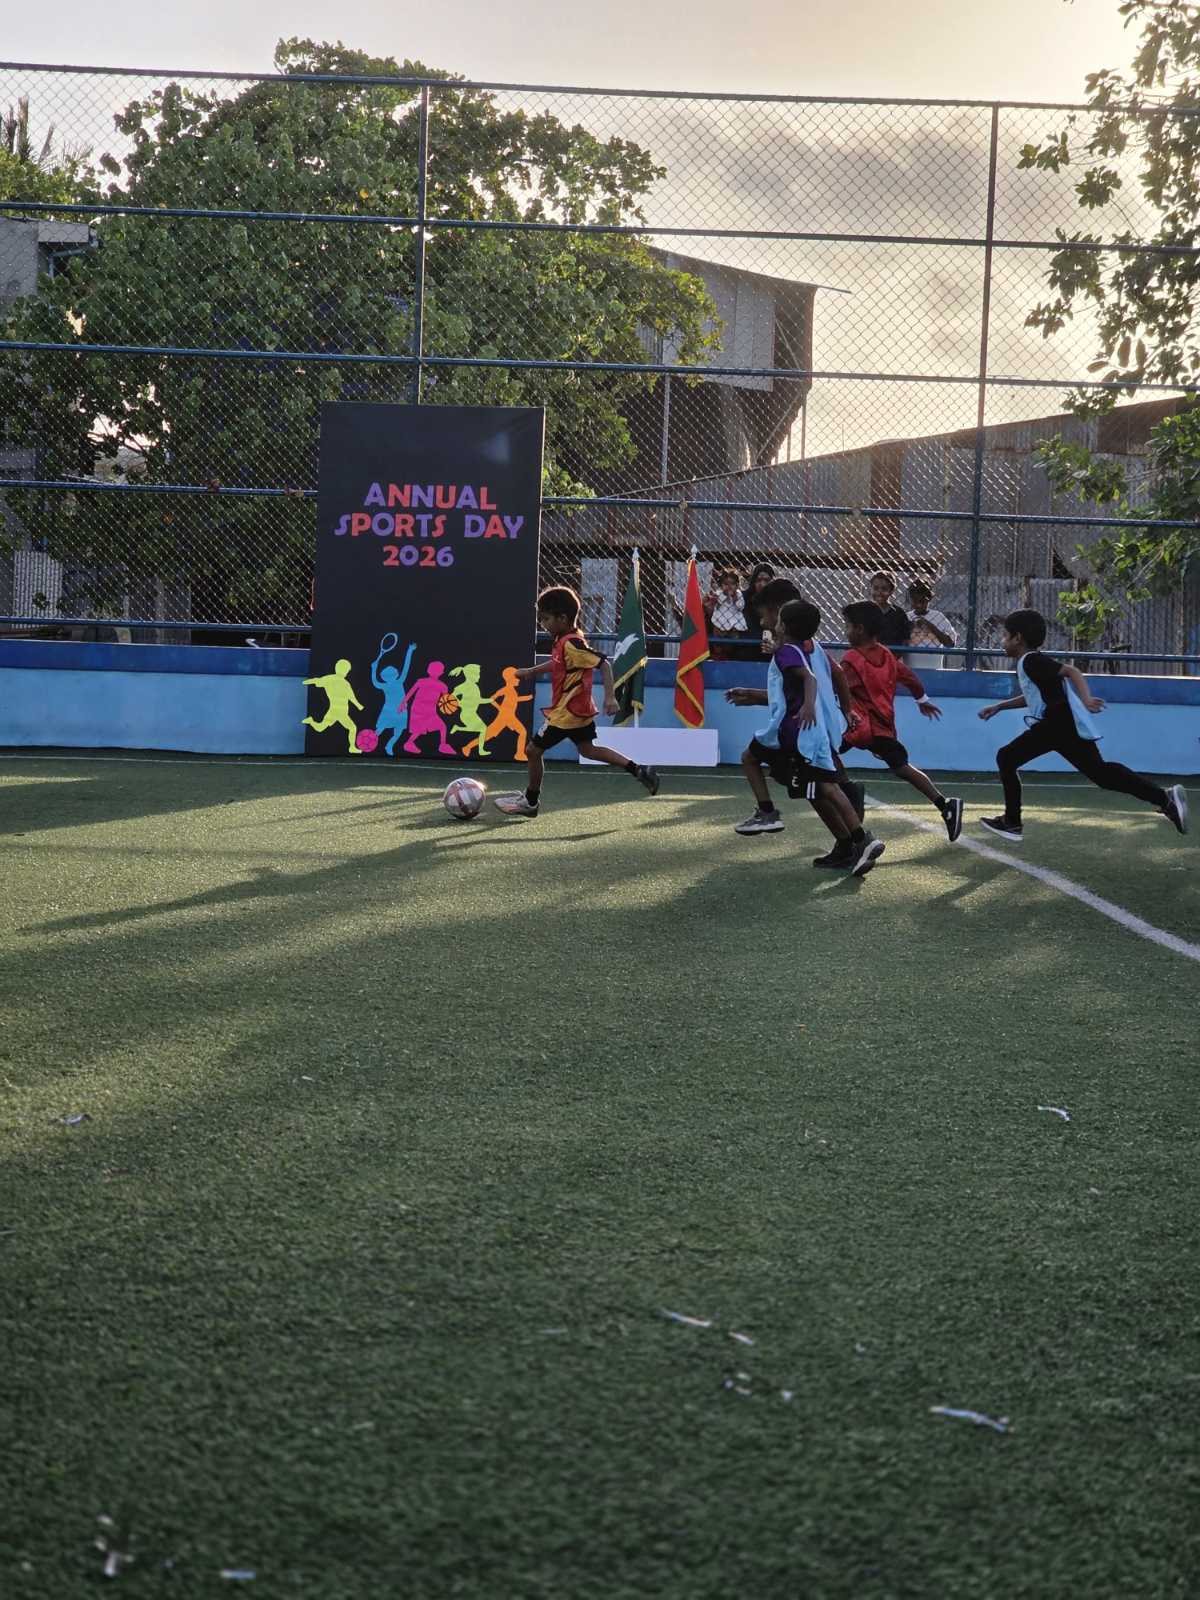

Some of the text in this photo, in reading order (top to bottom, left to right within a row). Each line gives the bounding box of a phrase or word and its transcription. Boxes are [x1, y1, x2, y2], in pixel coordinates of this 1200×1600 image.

[364, 482, 497, 510] ANNUAL
[334, 512, 524, 538] SPORTS DAY
[383, 545, 454, 567] 2026
